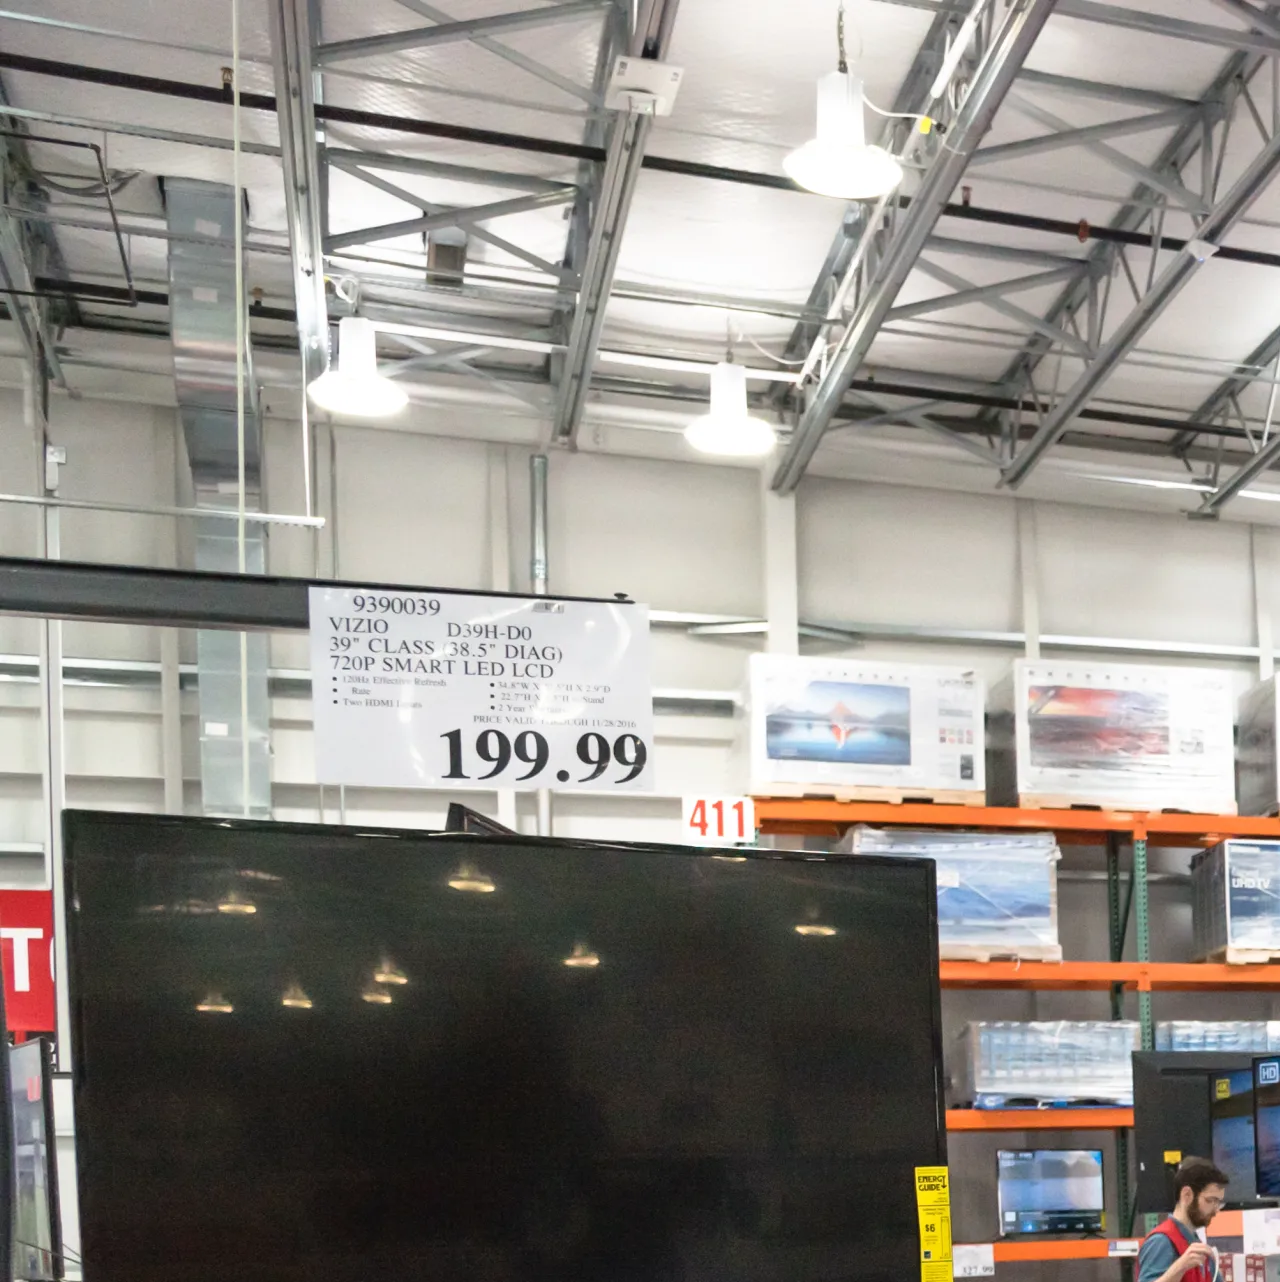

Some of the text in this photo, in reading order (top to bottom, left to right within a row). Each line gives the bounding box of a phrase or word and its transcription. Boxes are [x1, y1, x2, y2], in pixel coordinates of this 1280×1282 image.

[353, 595, 441, 616] 9390039
[329, 617, 532, 641] VIZIO D39H-D0
[330, 637, 360, 652] 39"
[368, 638, 435, 655] CLASS
[504, 644, 563, 663] DIAG)
[330, 655, 555, 679] 720P SMART LED LCD
[440, 728, 648, 785] 199.99
[689, 800, 747, 839] 411
[1261, 1065, 1279, 1080] HD
[917, 1175, 945, 1184] ENERGY
[918, 1184, 941, 1192] GUIDE
[925, 1224, 936, 1233] $6
